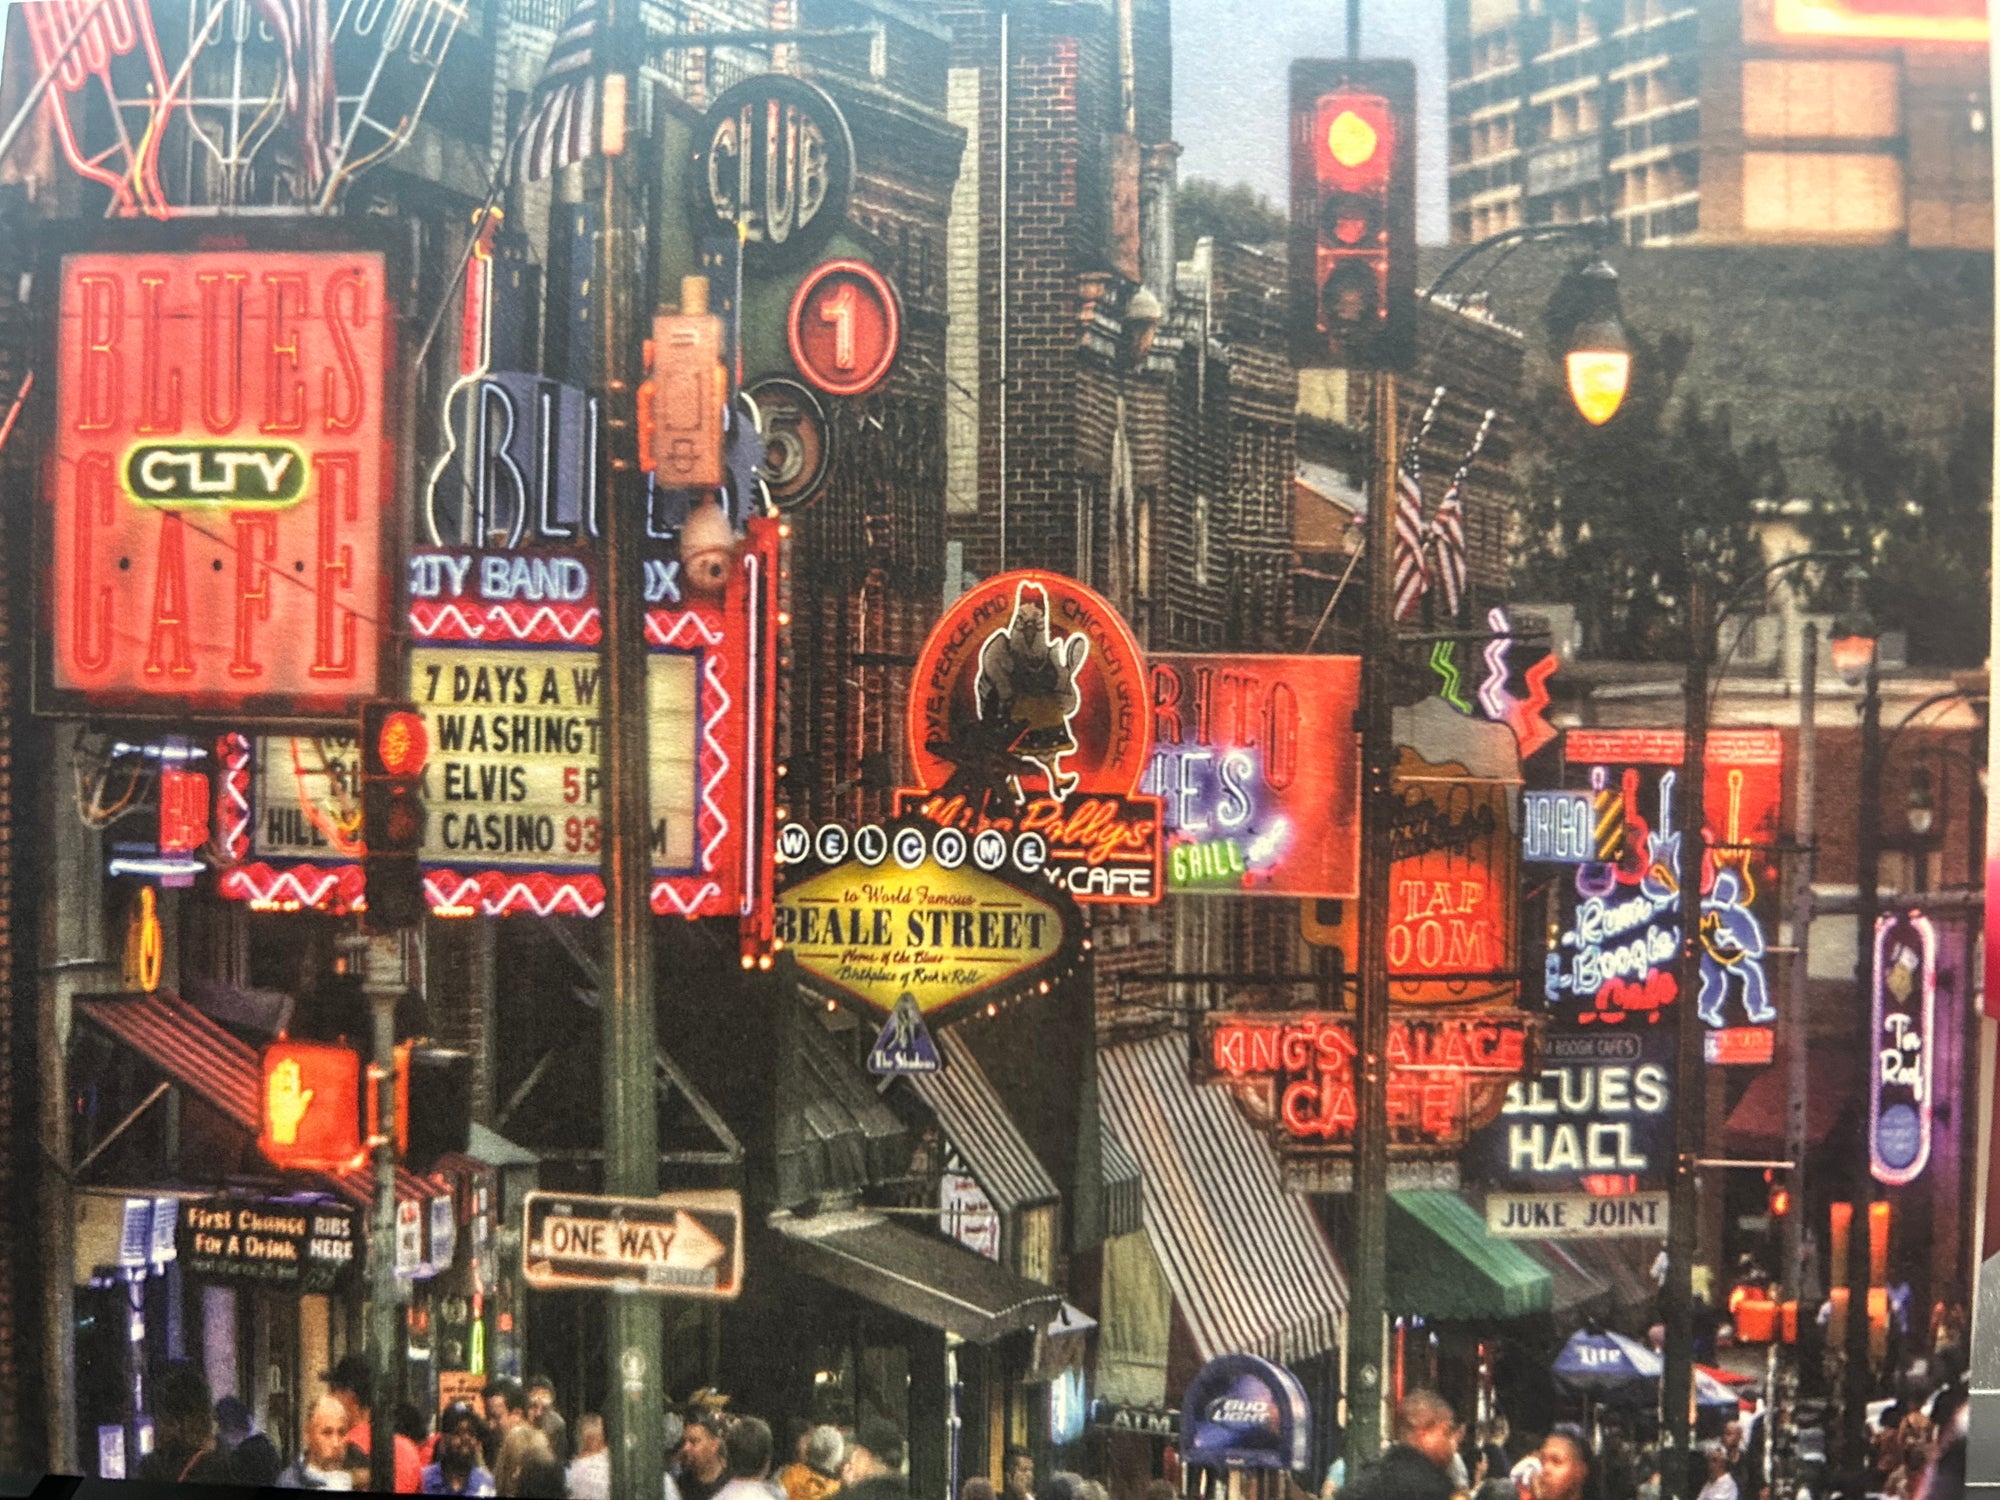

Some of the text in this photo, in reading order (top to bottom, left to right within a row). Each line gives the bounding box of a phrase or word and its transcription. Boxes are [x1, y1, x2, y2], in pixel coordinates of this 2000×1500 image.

[708, 98, 829, 245] CLUB
[821, 282, 856, 370] 1
[76, 267, 369, 437] BLUES
[140, 452, 294, 493] CITY
[72, 450, 354, 680] CAFE
[410, 554, 588, 600] ITY BAND
[972, 593, 1009, 625] AND
[426, 665, 441, 701] 7
[453, 665, 527, 704] DAYS
[539, 668, 560, 704] A
[438, 714, 600, 754] WASHINGT
[444, 763, 527, 802] ELVIS
[441, 813, 554, 853] CASINO
[776, 823, 1046, 873] WELCOME
[844, 883, 977, 906] to World Famous
[1067, 866, 1151, 897] CAFE
[1399, 880, 1483, 922] TAP
[776, 906, 1046, 950] BEALE STREET
[1388, 920, 1489, 968] OOM
[880, 950, 891, 966] of
[892, 950, 911, 964] the
[1385, 1026, 1525, 1070] ALACE
[1509, 1123, 1648, 1170] HALL
[188, 1207, 232, 1231] First
[238, 1209, 306, 1237] Chance
[314, 1215, 350, 1238] RIBS
[1503, 1201, 1661, 1228] JUKE JOINT
[194, 1231, 223, 1256] For
[227, 1235, 241, 1256] A
[245, 1236, 298, 1262] Drink
[309, 1238, 353, 1261] HERE
[552, 1221, 675, 1262] ONE WAY
[1113, 1409, 1171, 1435] ATM
[1212, 1411, 1271, 1424] LIGHT
[1222, 1399, 1269, 1414] BUD
